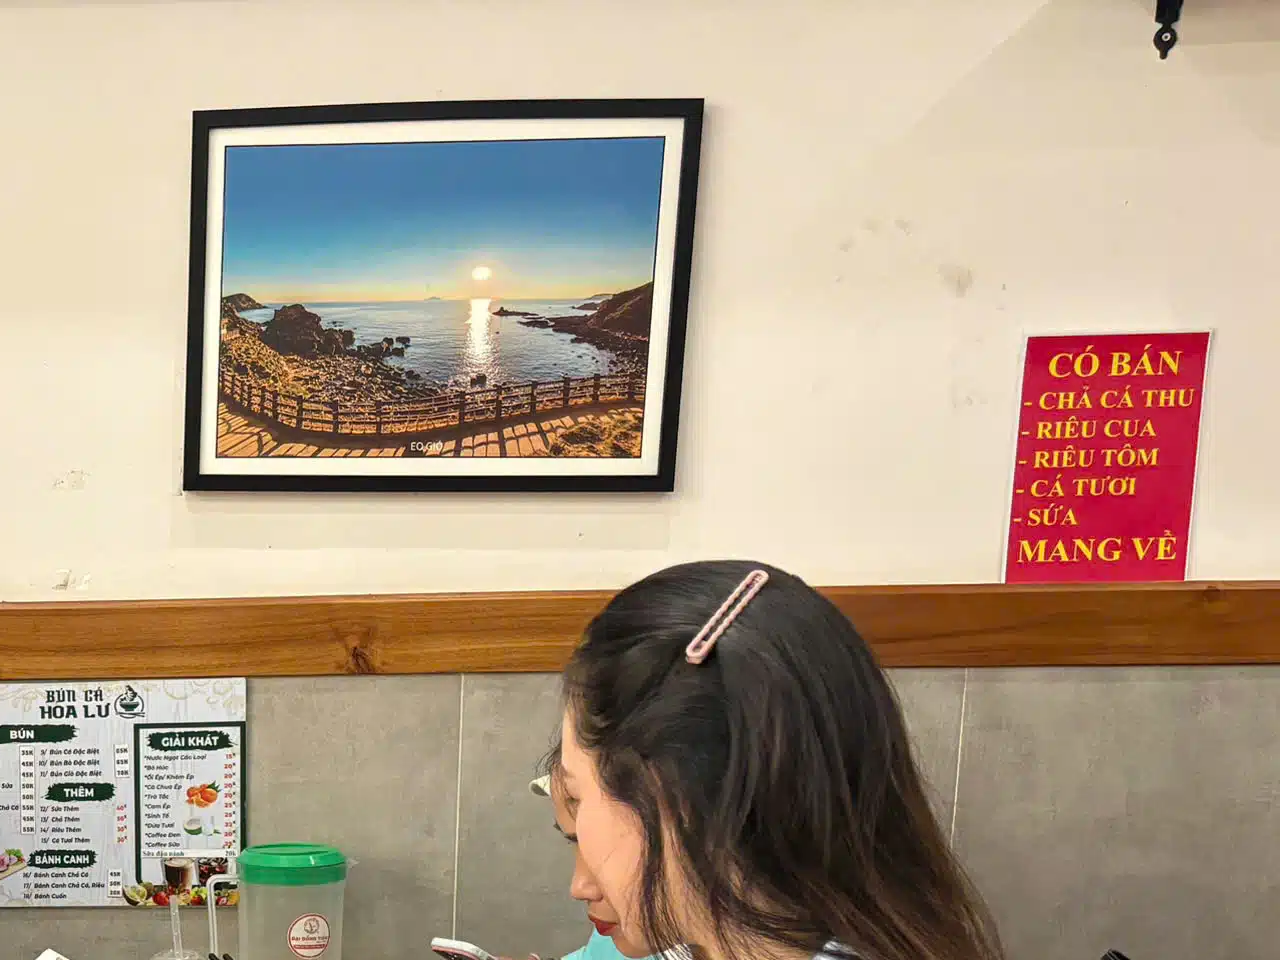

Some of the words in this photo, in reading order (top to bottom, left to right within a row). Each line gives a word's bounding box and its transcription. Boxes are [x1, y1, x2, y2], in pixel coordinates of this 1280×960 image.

[1049, 345, 1099, 378] CÓ
[1108, 344, 1182, 376] BÁN
[1039, 387, 1093, 410] CHẢ
[1100, 385, 1134, 409] CÁ
[1142, 389, 1195, 407] THU
[1036, 416, 1097, 440] RIÊU
[1104, 420, 1156, 437] CUA
[1033, 445, 1095, 469] RIÊU
[1101, 444, 1159, 466] TÔM
[1030, 474, 1064, 497] CÁ
[1073, 475, 1136, 496] TƯƠI
[1028, 503, 1079, 526] SỨA
[1017, 537, 1122, 563] MANG
[1131, 530, 1177, 560] VỀ
[45, 688, 76, 703] BÚN
[83, 687, 103, 702] CÁ
[39, 705, 77, 719] HOA
[82, 703, 111, 718] LƯ
[10, 728, 34, 739] BÚN
[161, 734, 185, 746] GIẢI
[188, 734, 219, 746] KHÁT
[64, 786, 94, 798] THÊM
[35, 853, 61, 864] BÁNH
[63, 855, 89, 864] CANH
